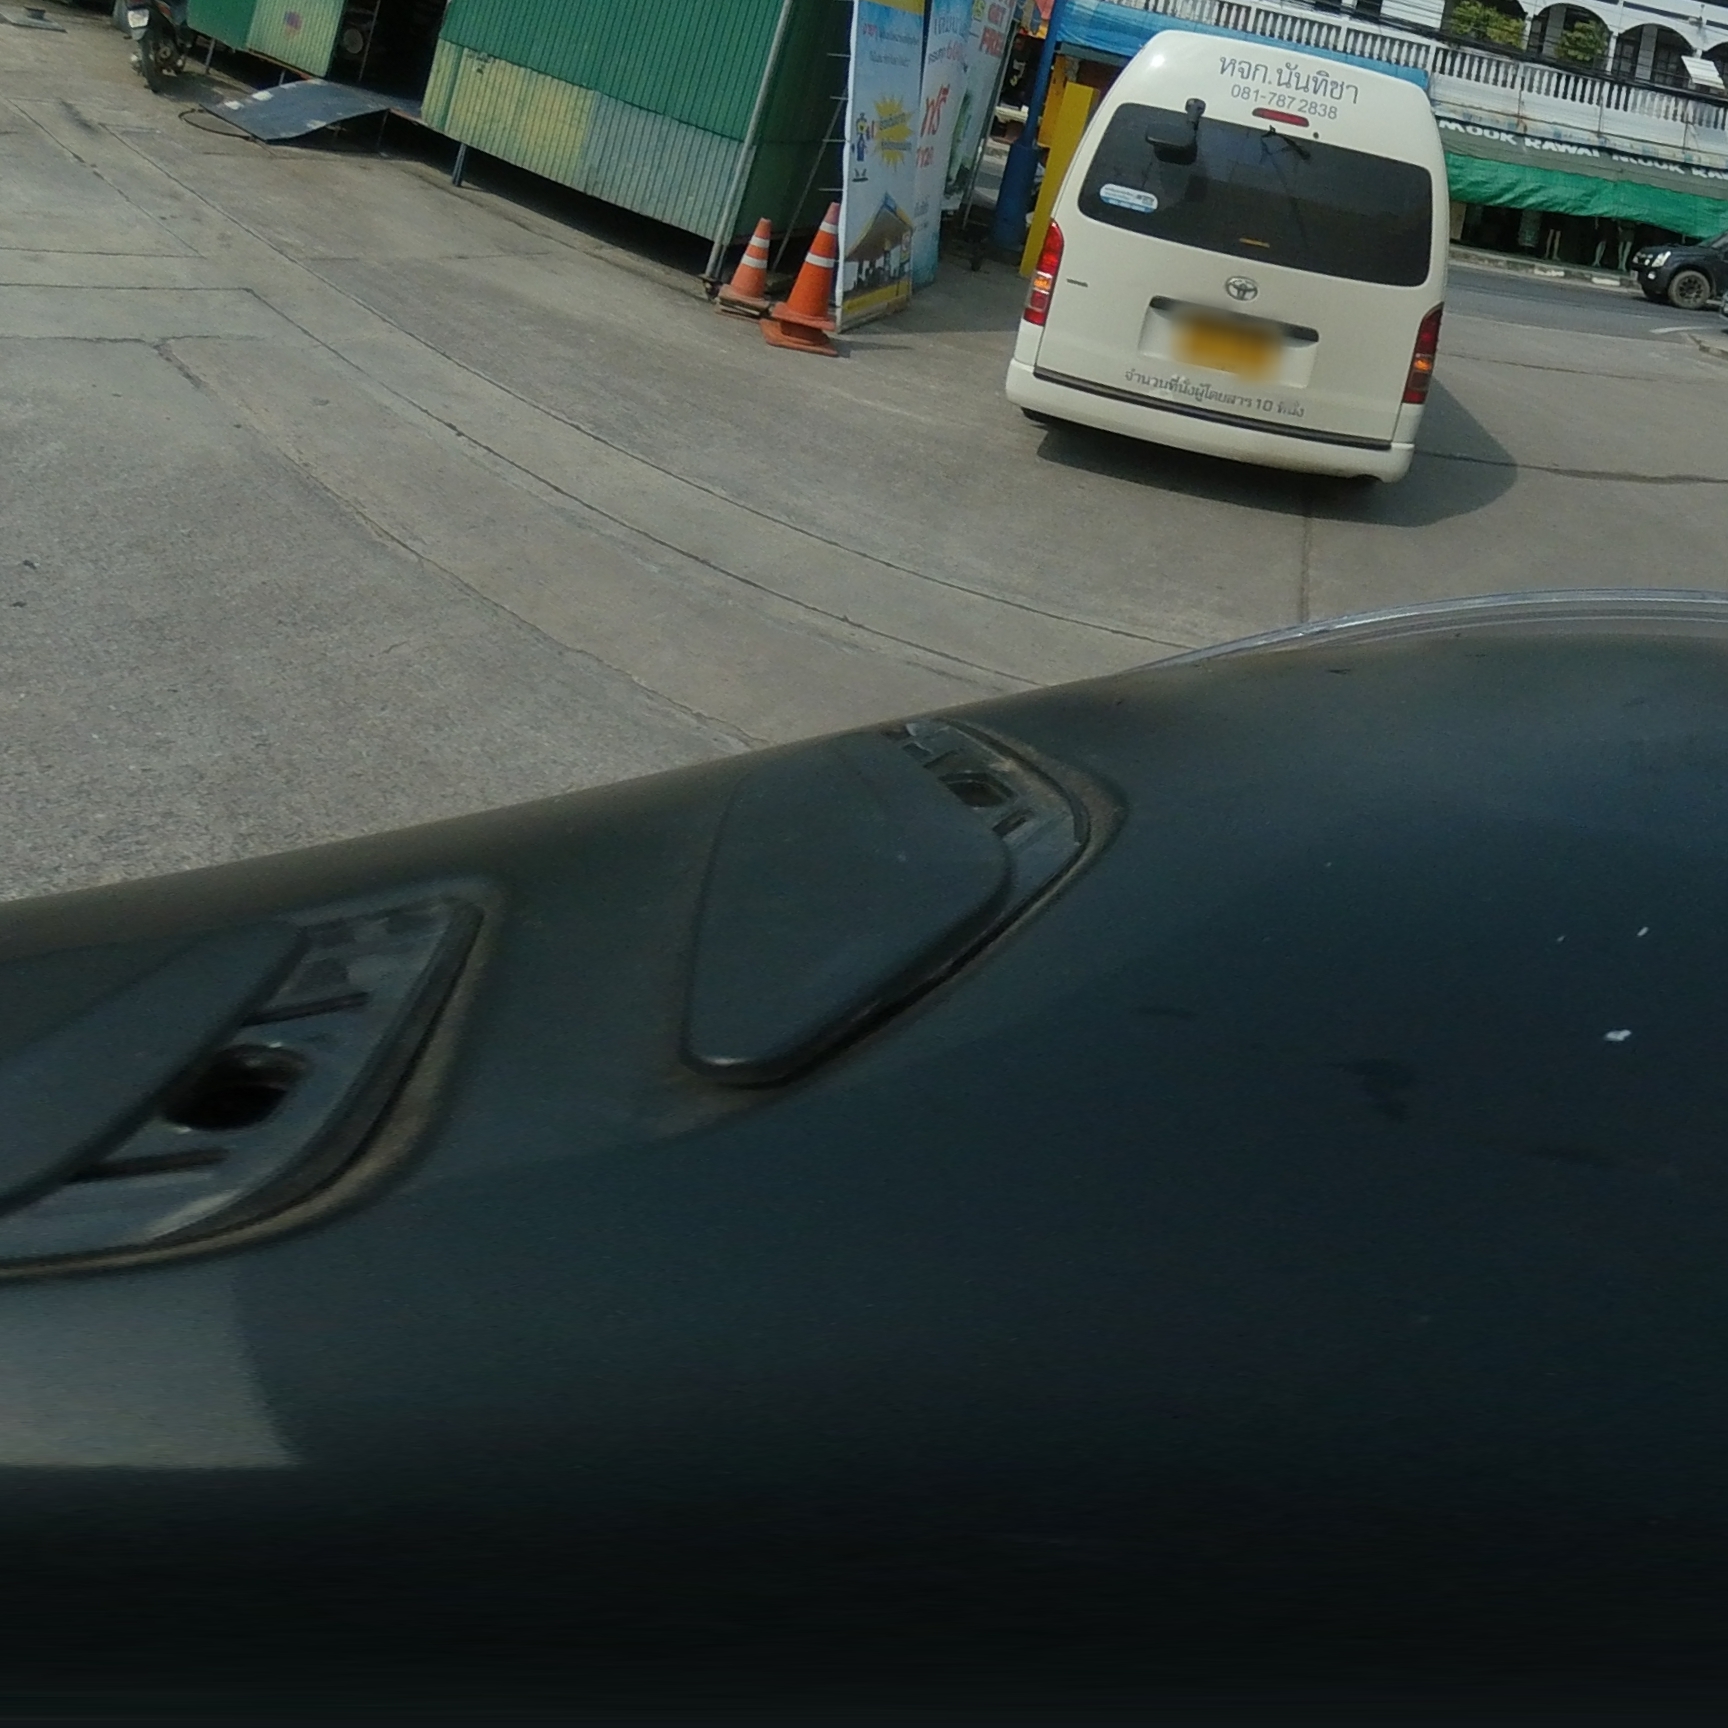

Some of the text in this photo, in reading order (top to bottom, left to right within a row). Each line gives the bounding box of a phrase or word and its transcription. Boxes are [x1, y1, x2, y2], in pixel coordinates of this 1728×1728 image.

[1219, 56, 1359, 104] หจก.นันทิชา
[1297, 99, 1338, 120] 2838
[1439, 119, 1517, 146] MOOK
[1524, 137, 1600, 158] RAWAI
[1255, 398, 1273, 412] 10
